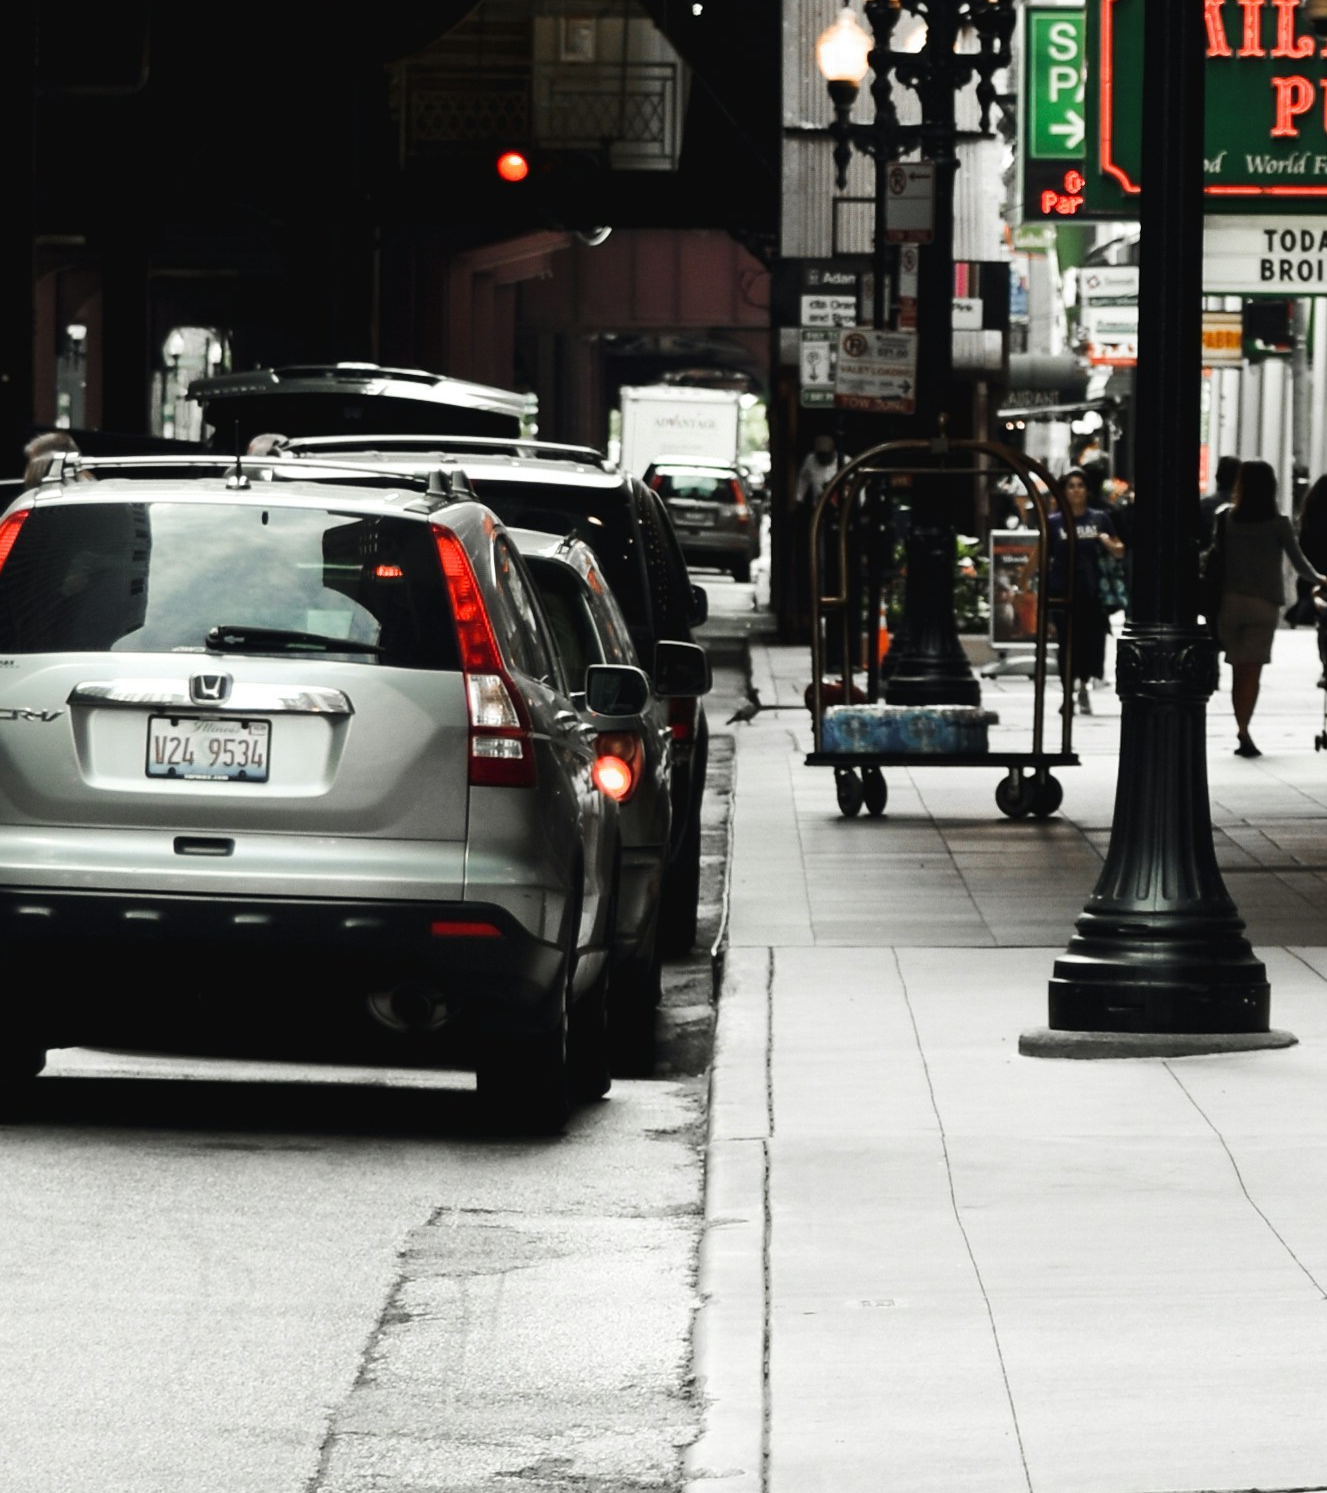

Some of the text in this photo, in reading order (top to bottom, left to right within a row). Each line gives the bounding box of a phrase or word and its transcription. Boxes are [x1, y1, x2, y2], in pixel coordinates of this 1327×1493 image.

[1245, 150, 1306, 175] World
[154, 735, 264, 768] V24 9534
